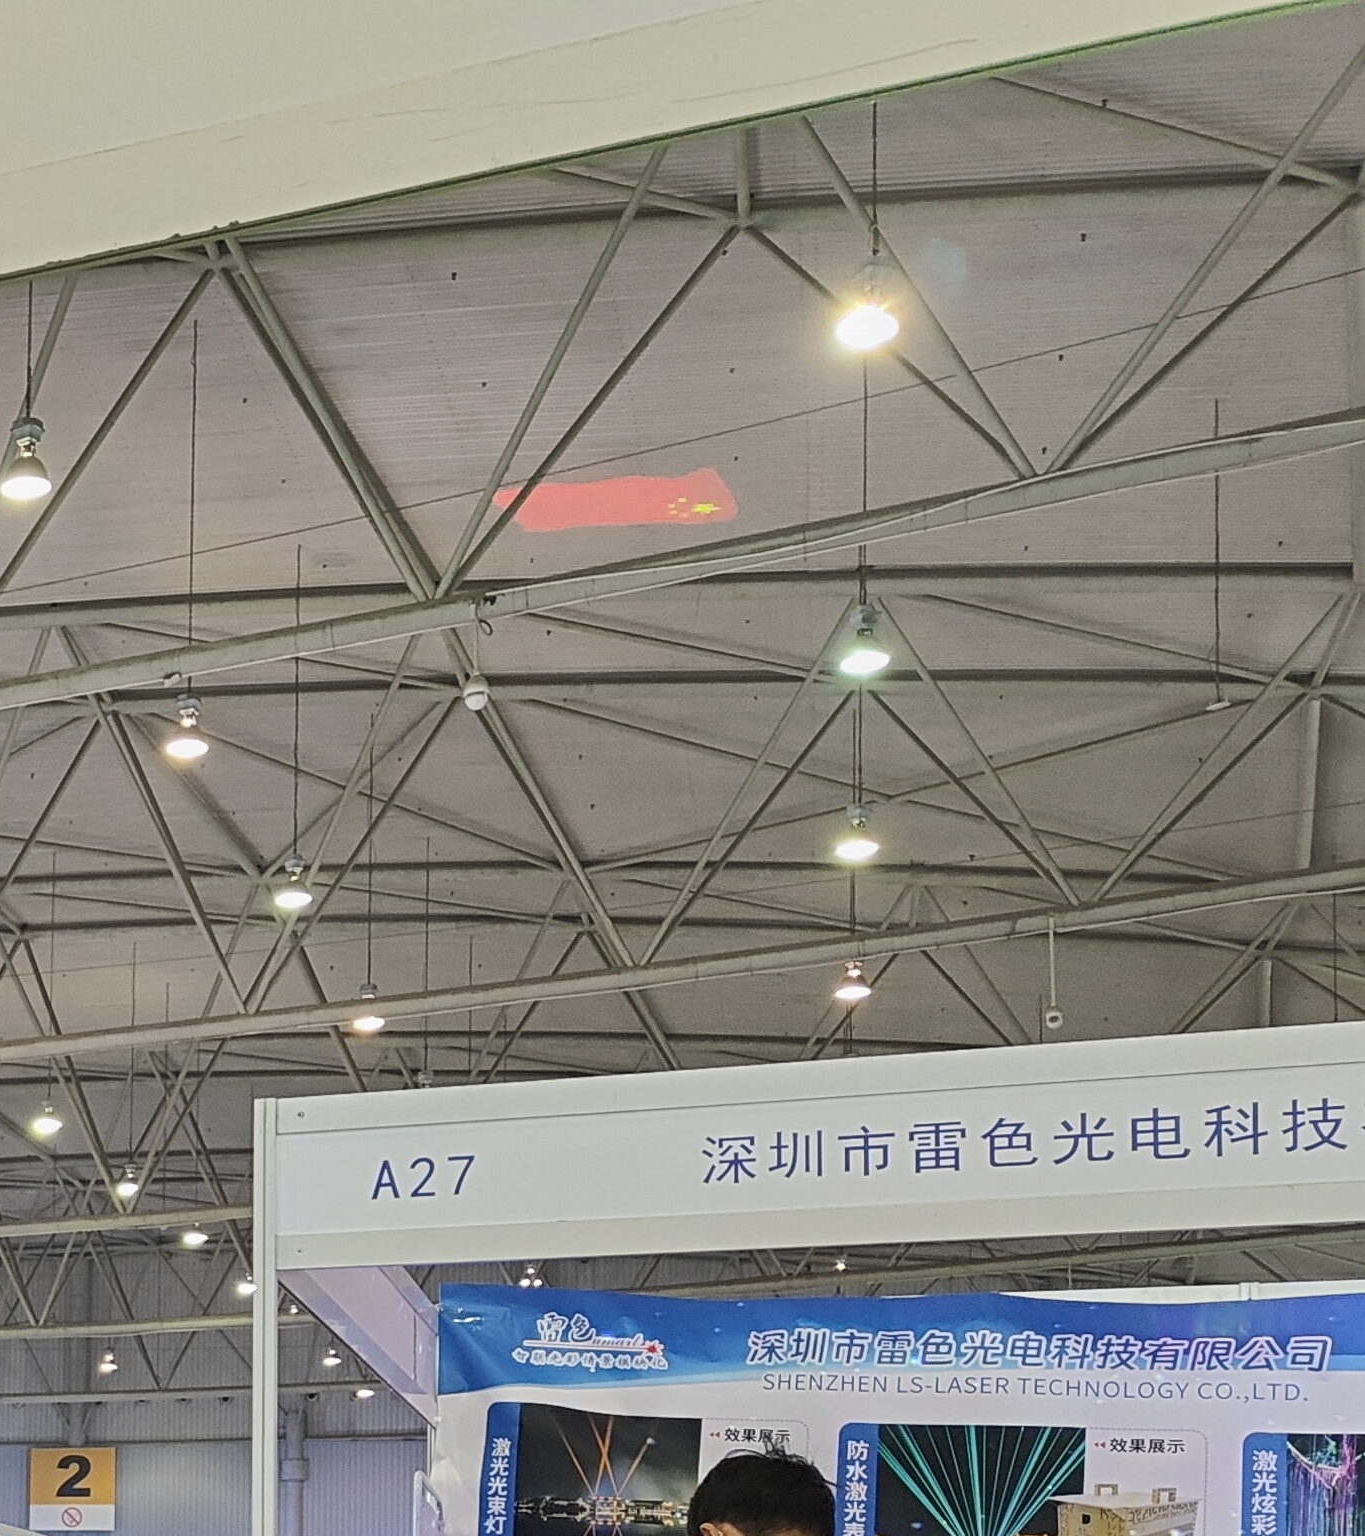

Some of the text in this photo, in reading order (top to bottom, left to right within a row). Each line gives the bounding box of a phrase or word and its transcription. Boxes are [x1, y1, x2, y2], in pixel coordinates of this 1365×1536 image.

[701, 1097, 1365, 1185] 深圳市雷色光电科技
[372, 1155, 475, 1199] A27
[746, 1329, 1335, 1372] 深圳市雷色光电科技有限公司
[762, 1373, 1311, 1403] SHENZHEN LS-LASER TECHNOLOGY CO.,LTD.
[724, 1427, 791, 1443] 效果展示
[1109, 1437, 1186, 1455] 效果展示
[56, 1455, 91, 1497] 2
[484, 1437, 512, 1536] 激光光束灯
